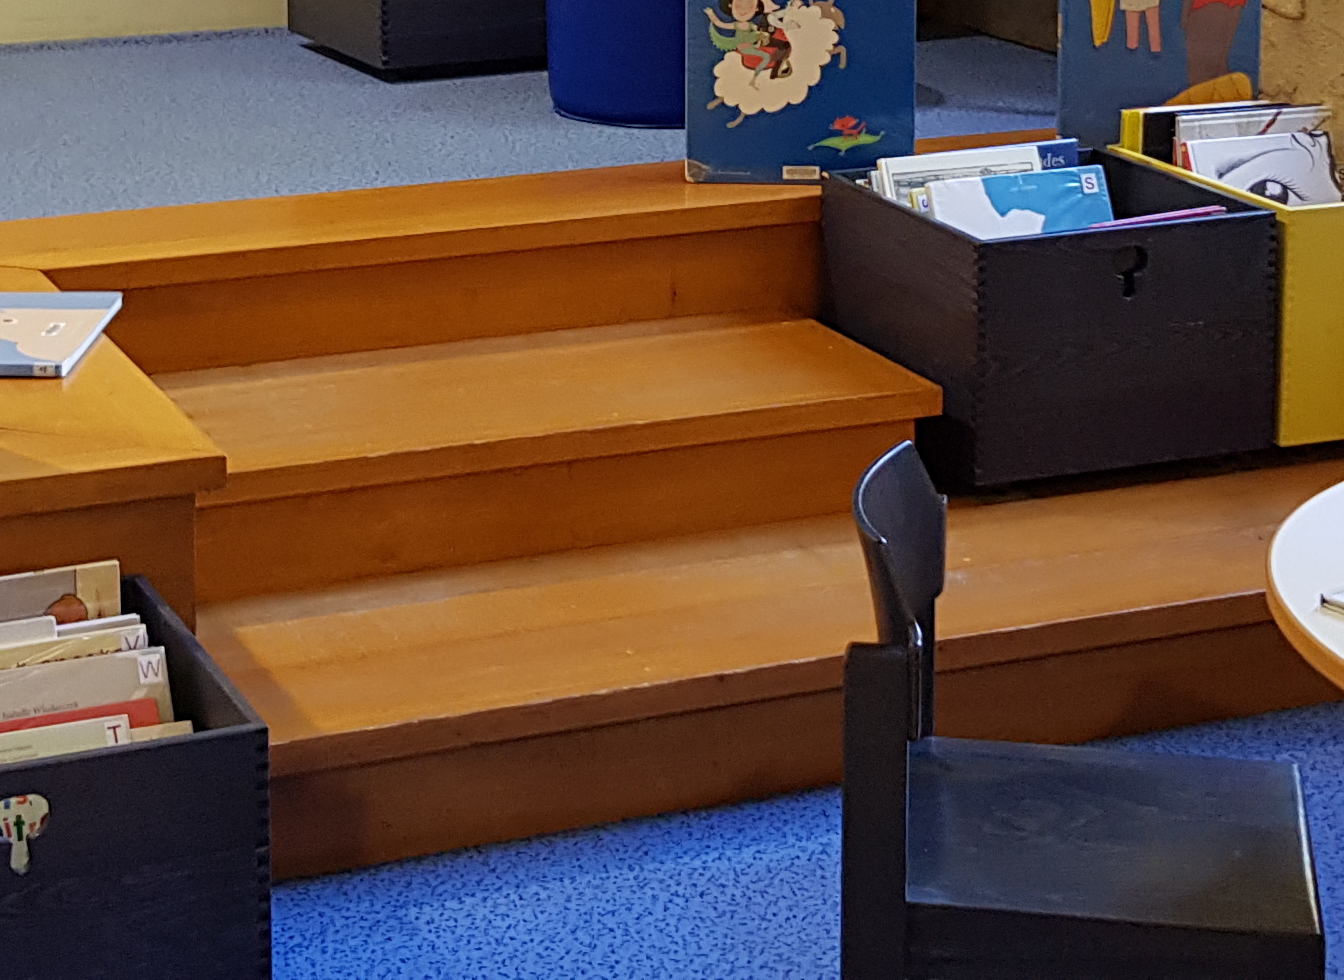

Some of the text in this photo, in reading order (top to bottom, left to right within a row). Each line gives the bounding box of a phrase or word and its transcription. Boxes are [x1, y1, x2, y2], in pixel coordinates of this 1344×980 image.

[1084, 176, 1096, 191] S
[139, 658, 162, 680] W
[107, 724, 122, 745] T
